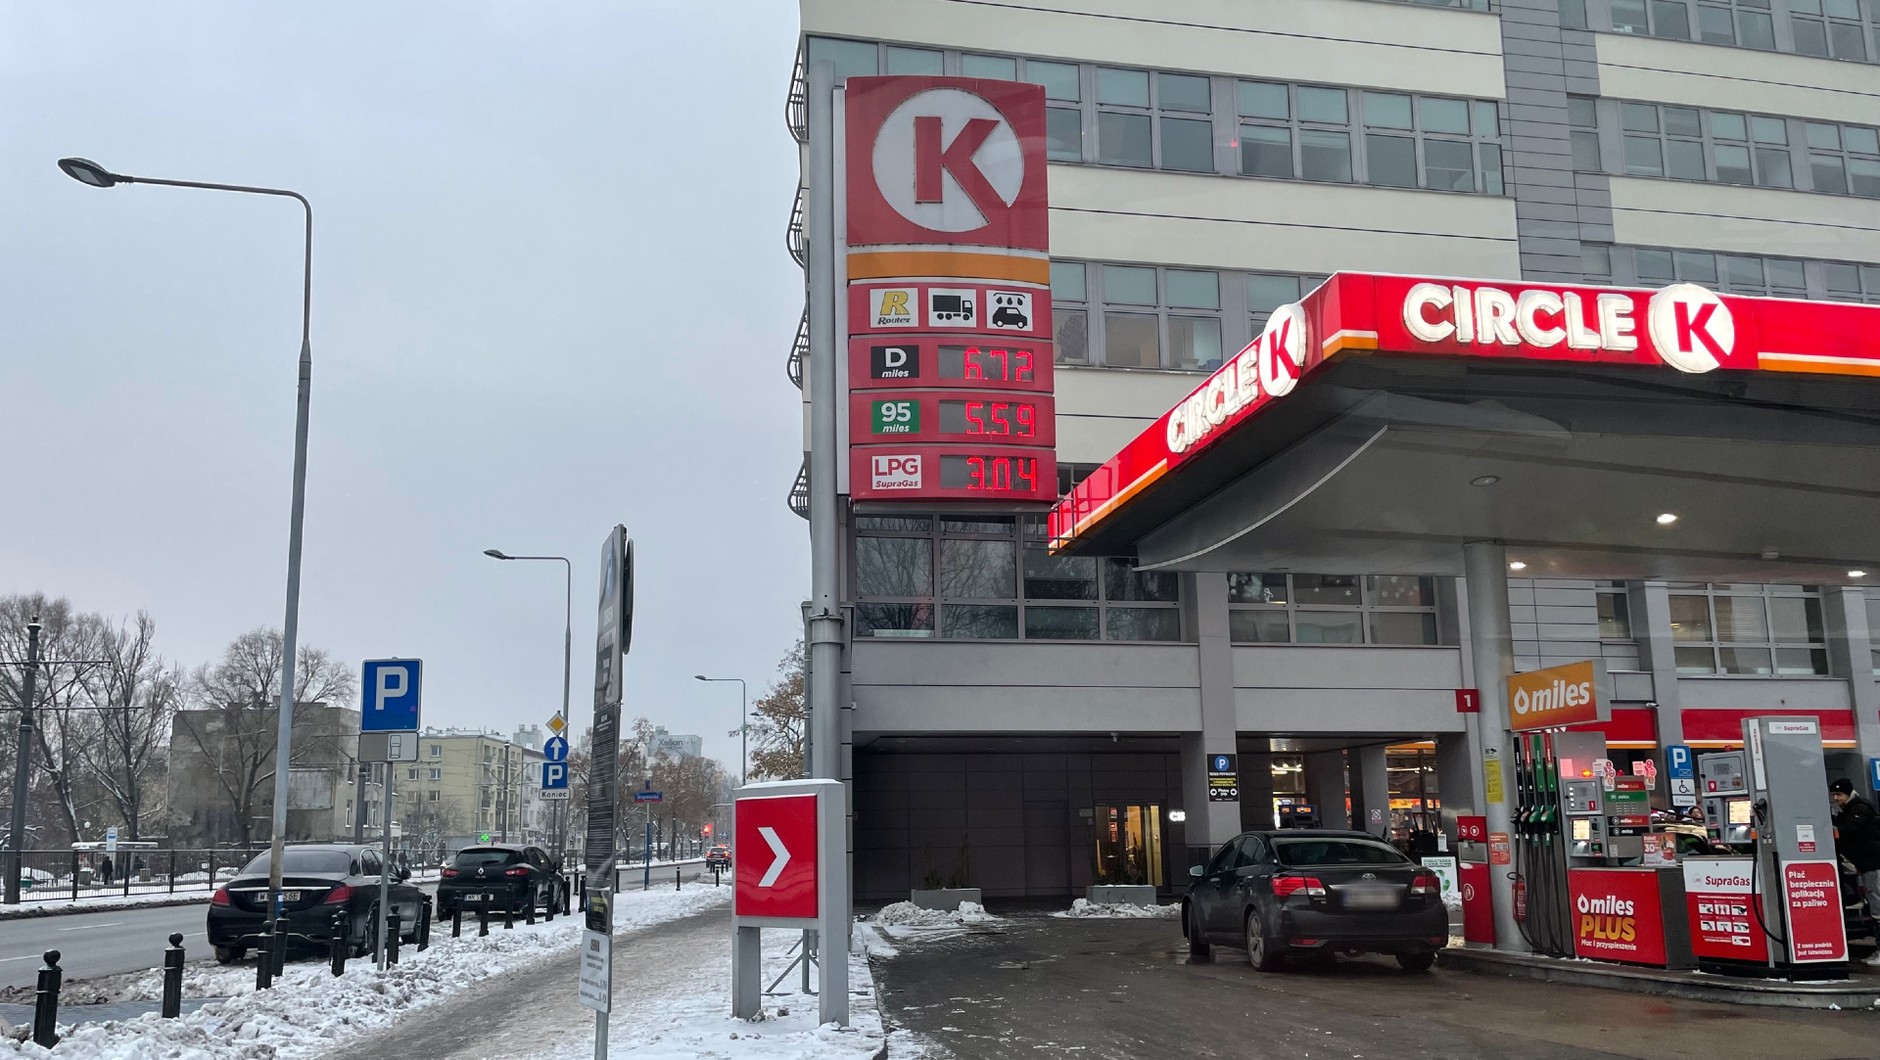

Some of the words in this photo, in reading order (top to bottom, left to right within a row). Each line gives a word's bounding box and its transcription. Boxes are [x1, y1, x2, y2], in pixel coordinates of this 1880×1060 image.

[914, 115, 1009, 222] K
[877, 316, 911, 325] Routex
[1403, 282, 1638, 351] CIRCLE
[1674, 301, 1730, 365] K
[885, 348, 907, 367] D
[964, 347, 1034, 382] 6.72
[881, 369, 909, 378] miles
[1167, 345, 1259, 453] CIRCLE
[881, 402, 911, 422] 95
[965, 402, 1035, 437] 5.59
[882, 424, 910, 432] miles
[874, 457, 918, 476] LPG
[967, 457, 1039, 492] 3.04
[875, 479, 918, 488] SupraGas
[376, 666, 408, 710] P
[1531, 679, 1590, 712] miles
[1464, 694, 1471, 707] 1
[1218, 758, 1226, 768] P
[1672, 748, 1686, 768] P
[547, 765, 563, 785] P
[1644, 843, 1655, 852] 30
[1705, 875, 1750, 887] SupraGas
[1788, 870, 1806, 879] Płać
[1790, 880, 1834, 890] bezpiecznie
[1791, 889, 1825, 899] aplikacją
[1590, 895, 1635, 916] miles
[1802, 899, 1828, 909] paliwo
[1580, 914, 1636, 942] PLUS
